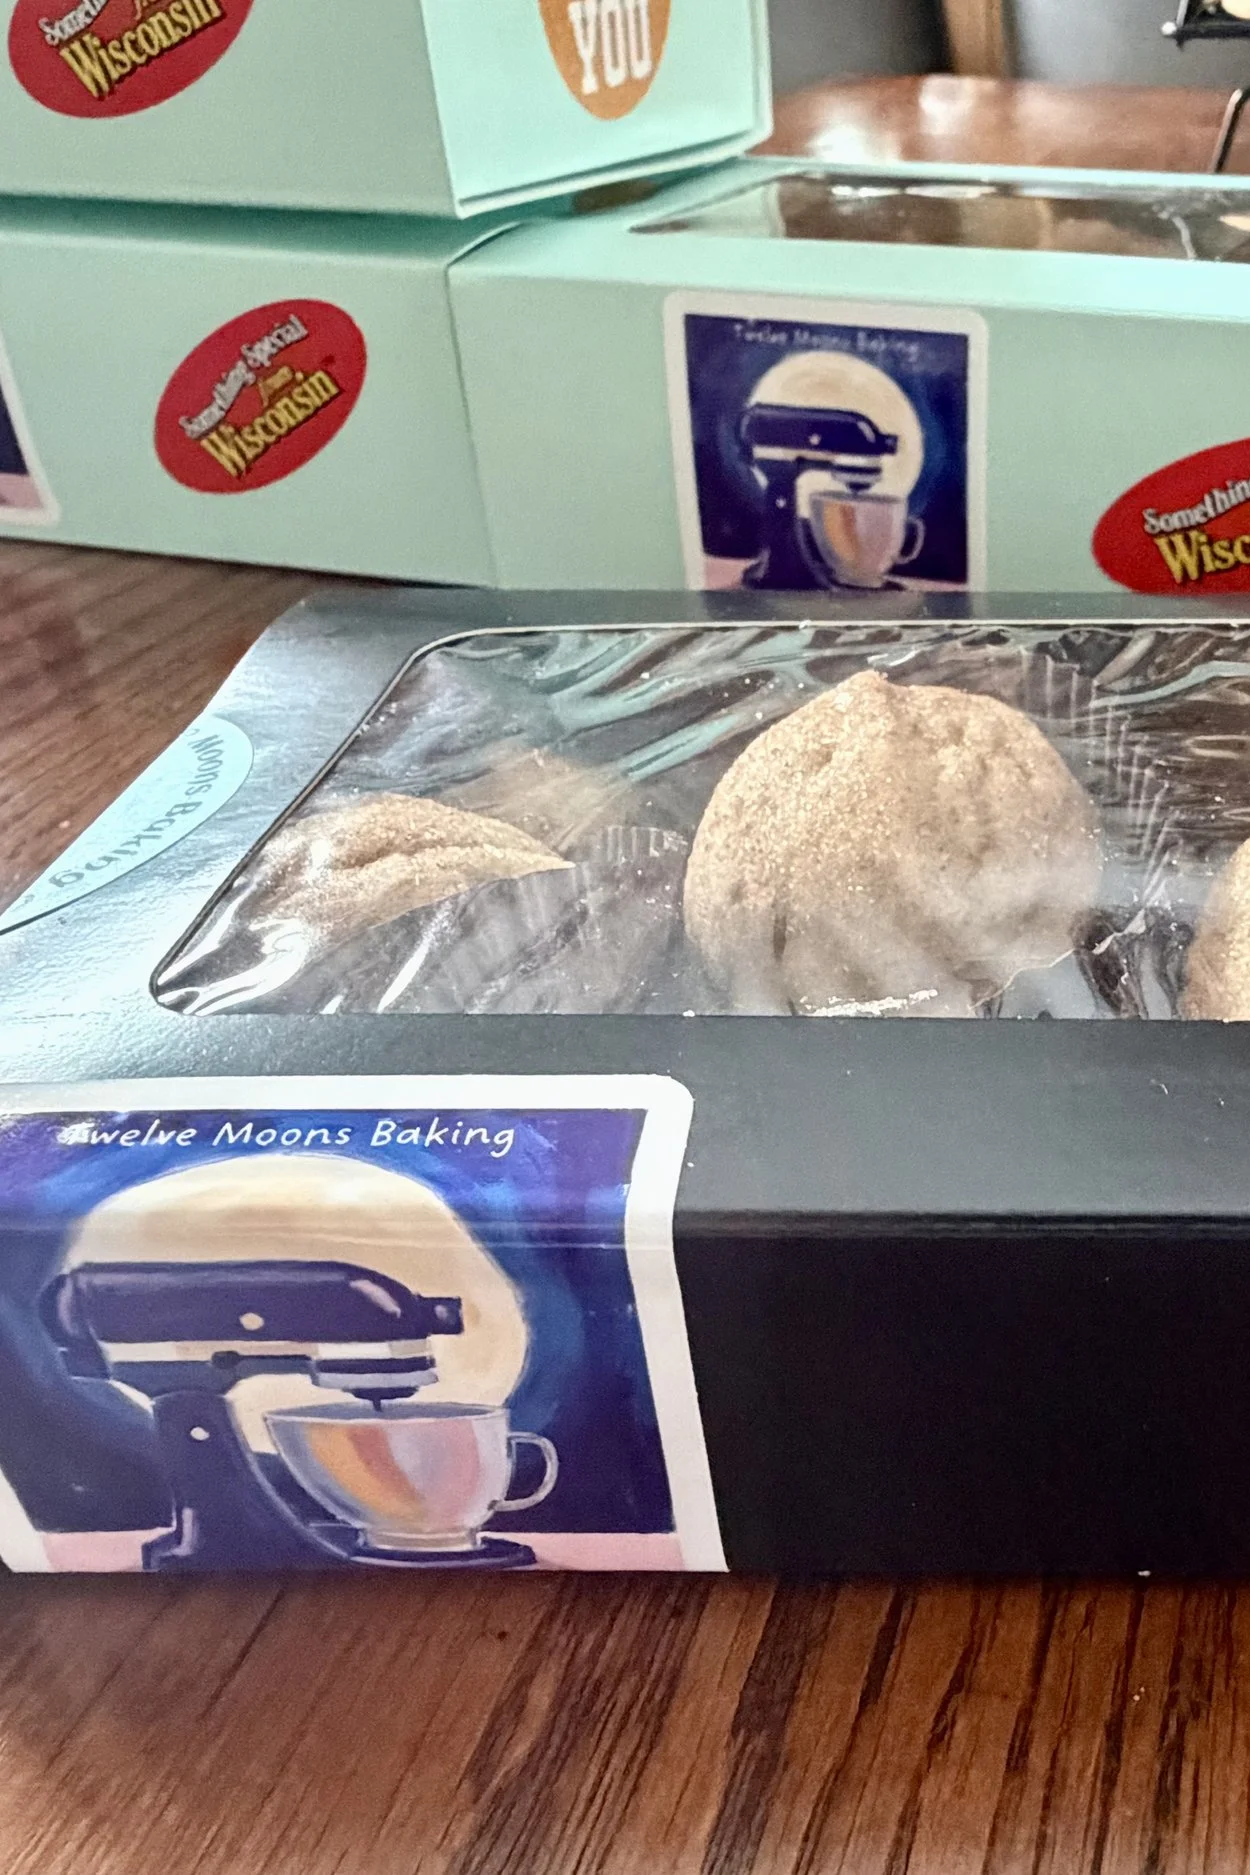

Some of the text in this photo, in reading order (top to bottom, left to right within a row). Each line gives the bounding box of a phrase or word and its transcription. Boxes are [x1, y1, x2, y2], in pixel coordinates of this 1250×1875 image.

[568, 0, 652, 95] YOU
[200, 370, 340, 477] Wisconsin
[48, 733, 225, 888] Moons Baking
[57, 1118, 515, 1158] Twelve Moons Baking
